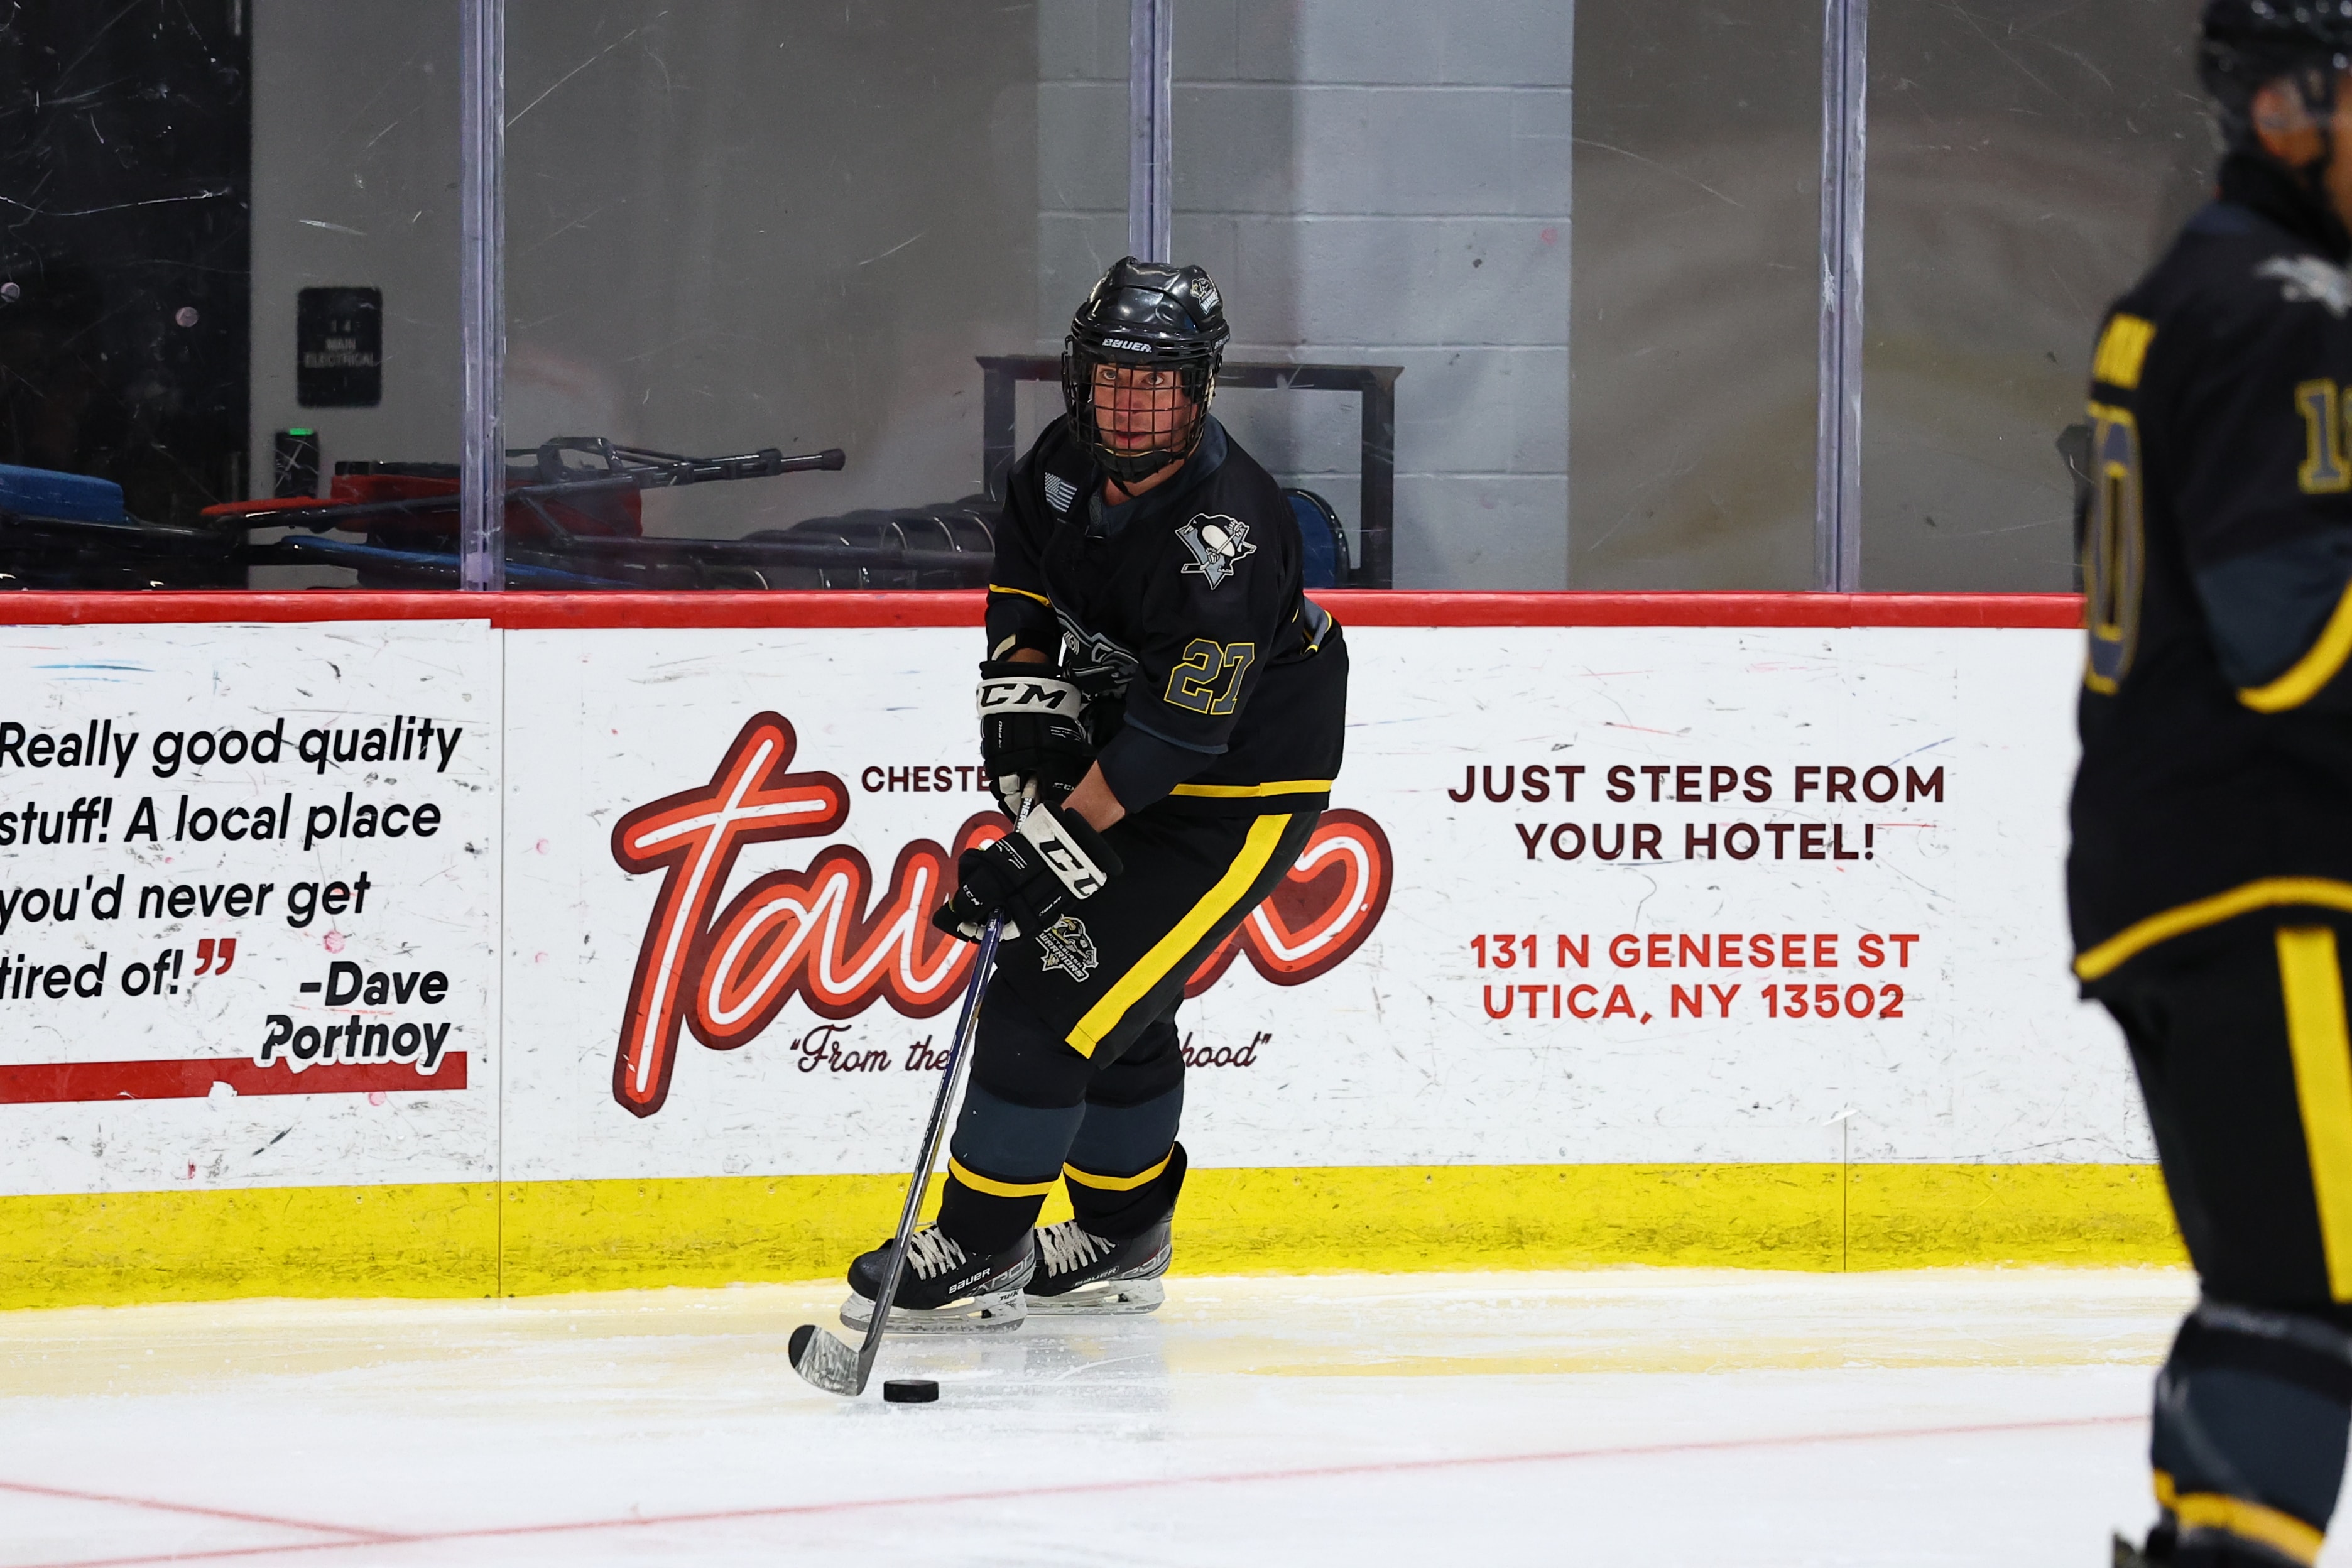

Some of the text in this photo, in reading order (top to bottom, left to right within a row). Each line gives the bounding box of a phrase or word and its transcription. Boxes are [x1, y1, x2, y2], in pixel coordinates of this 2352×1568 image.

[1102, 338, 1152, 353] BAUER
[980, 683, 1068, 709] CM
[1163, 638, 1255, 715] 27
[0, 715, 462, 778] Really good quality
[1448, 765, 1944, 803] JUST STEPS FROM
[0, 792, 441, 851] stuff! A local place
[1515, 823, 1873, 860] YOUR HOTEL!
[0, 871, 371, 935] you'd never get
[1038, 932, 1085, 977] WARRIORS
[1471, 934, 1919, 968] 131 N GENESEE ST
[0, 952, 107, 999] tired
[300, 961, 448, 1006] -Dave
[1484, 984, 1903, 1025] UTICA, NY 13502
[261, 1015, 450, 1067] Portnoy
[905, 1035, 950, 1072] the
[949, 1268, 991, 1294] BAUER
